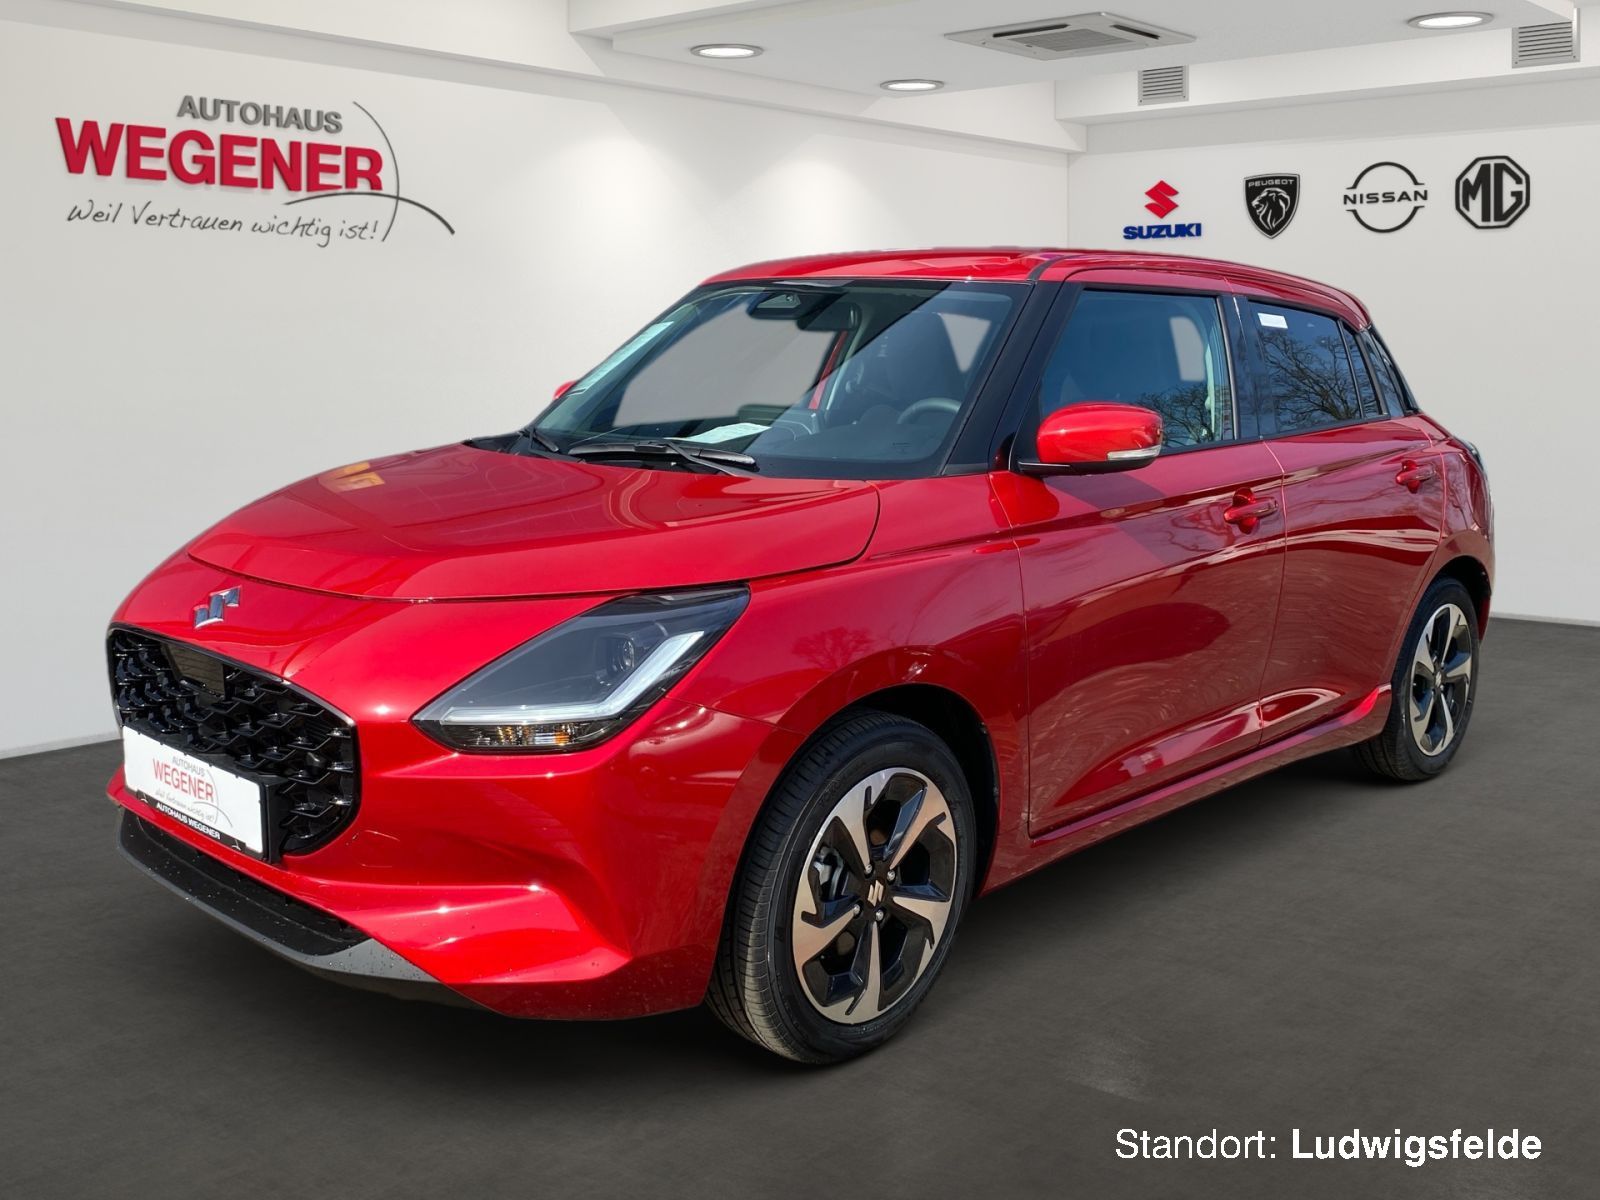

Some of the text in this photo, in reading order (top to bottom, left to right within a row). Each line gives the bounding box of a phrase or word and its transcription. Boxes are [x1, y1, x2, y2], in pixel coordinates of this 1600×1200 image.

[176, 95, 342, 133] AUTOHAUS
[55, 117, 383, 192] WEGENER
[1248, 178, 1295, 188] PEUGEOT
[1343, 189, 1428, 205] NISSAN
[1461, 162, 1524, 223] MG
[67, 199, 379, 247] Weil Vertrauen wichtig ist!
[1123, 223, 1202, 239] SUZUKI
[152, 758, 214, 803] WEGENER
[172, 756, 206, 776] AUTOHAUS
[156, 802, 188, 824] AUTOHAUS
[188, 818, 221, 840] WEGENER
